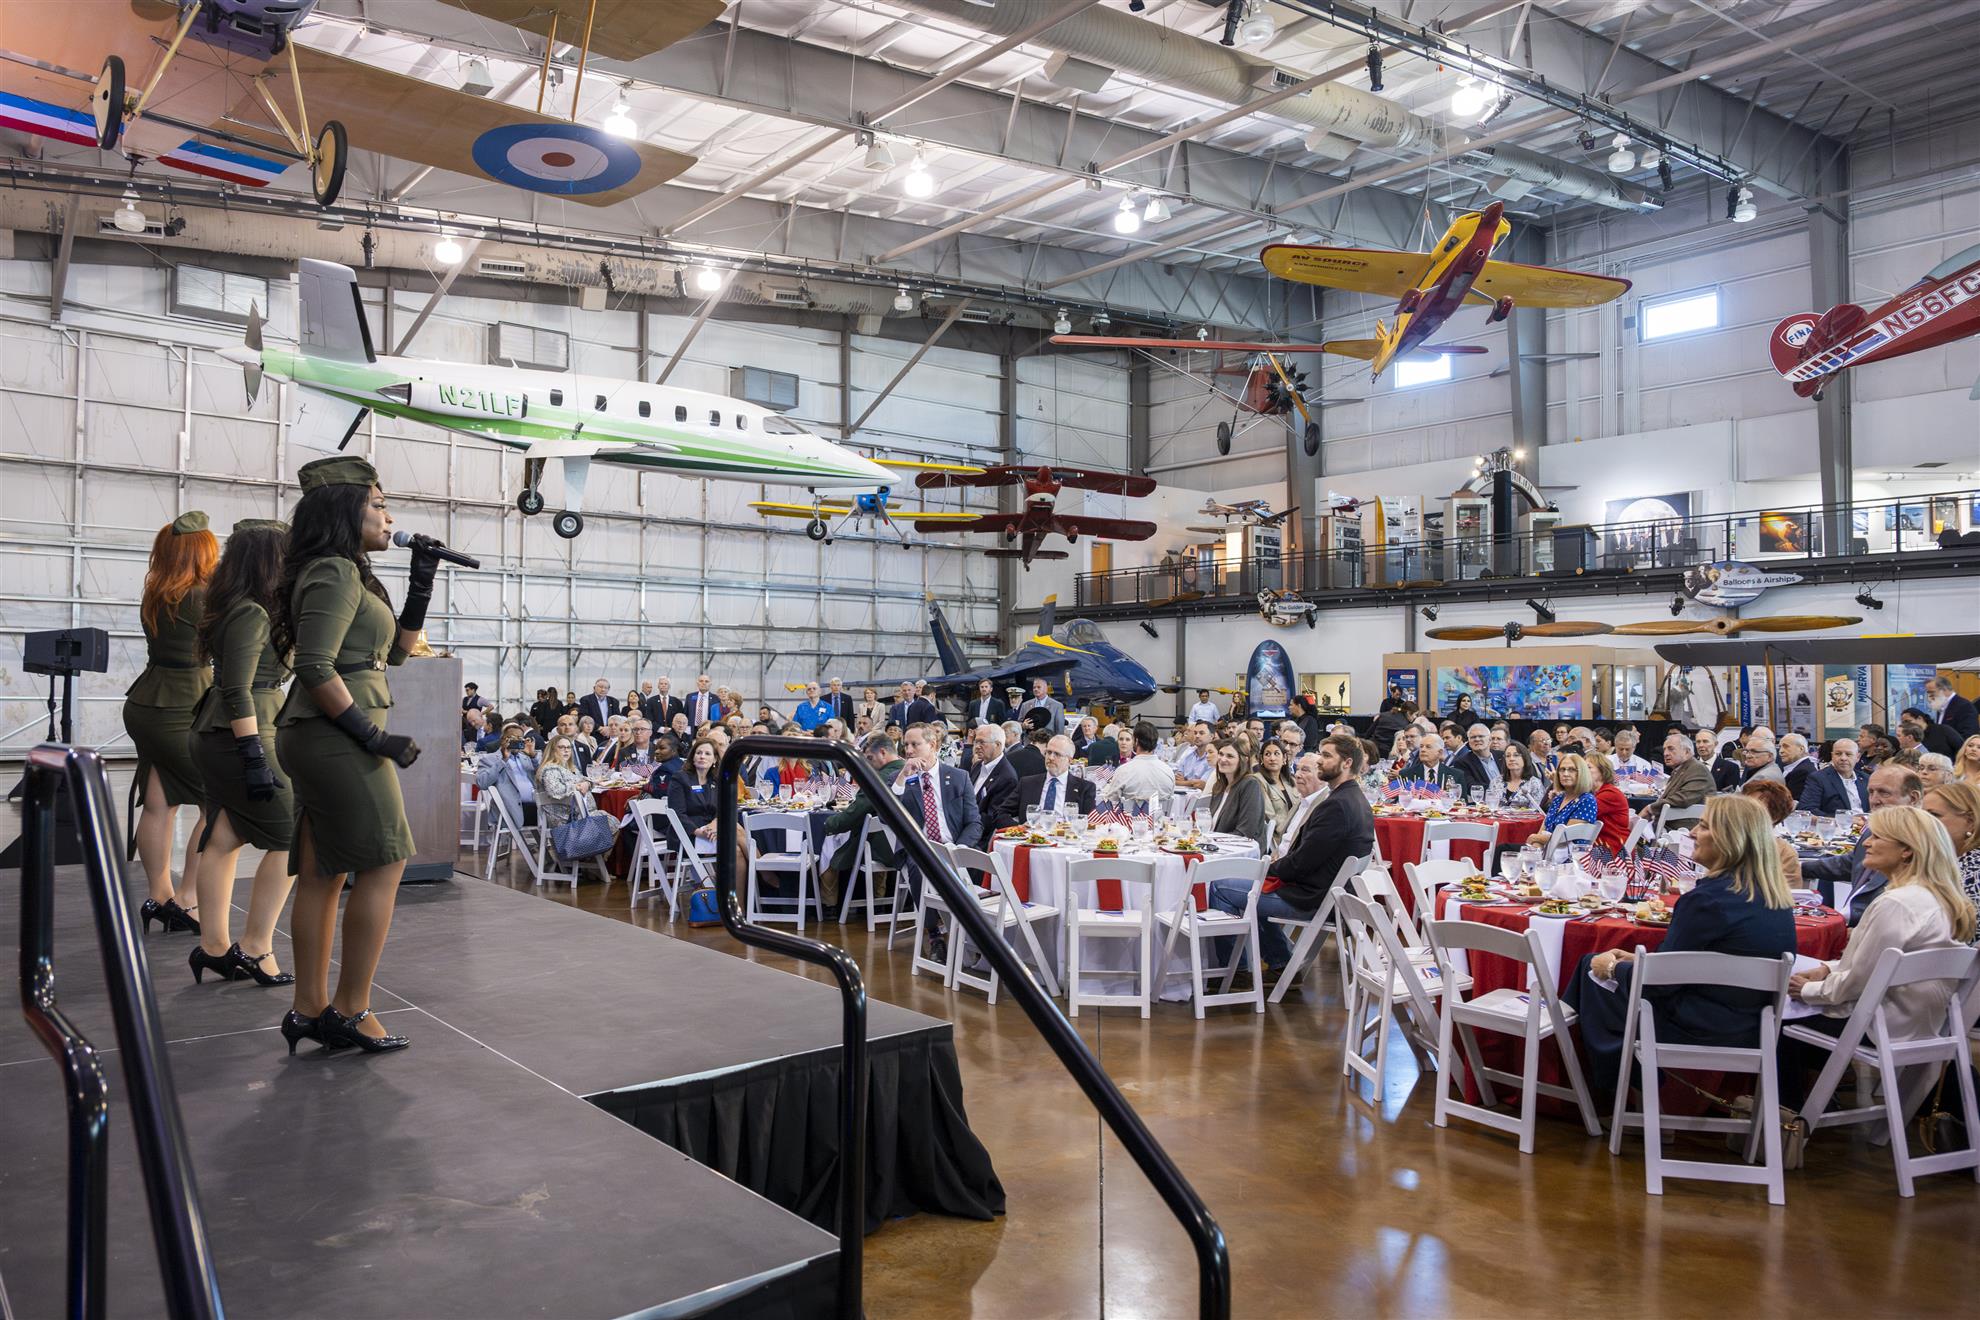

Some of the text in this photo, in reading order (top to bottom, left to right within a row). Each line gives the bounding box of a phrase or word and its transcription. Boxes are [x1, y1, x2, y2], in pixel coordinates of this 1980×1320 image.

[1313, 257, 1369, 267] SOURCE
[1788, 326, 1813, 344] FINA
[439, 383, 521, 416] N21LF
[1723, 578, 1756, 586] Balloons
[1764, 575, 1796, 585] Airships
[1857, 665, 1867, 703] MINERVA
